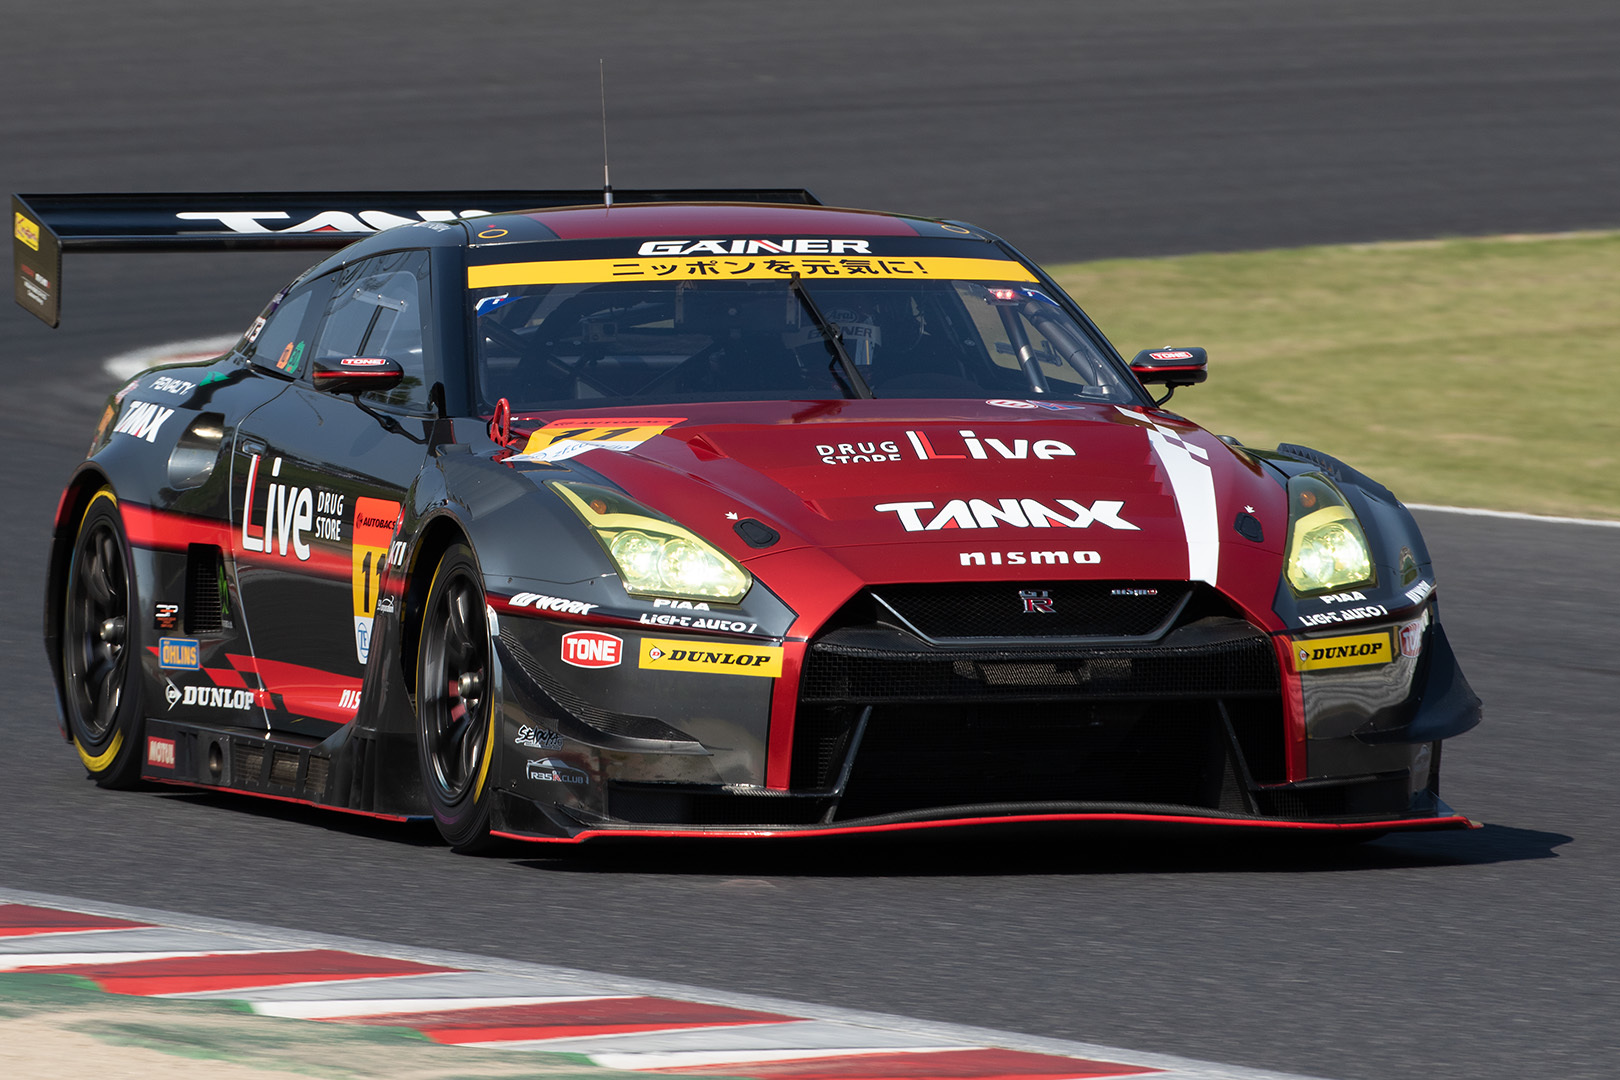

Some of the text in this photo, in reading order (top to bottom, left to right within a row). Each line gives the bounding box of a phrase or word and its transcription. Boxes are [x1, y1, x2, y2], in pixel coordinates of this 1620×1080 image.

[176, 211, 495, 233] TAN
[637, 239, 873, 256] GAINER
[612, 258, 927, 276] ニッポンを元気に!
[807, 325, 873, 340] GNER
[815, 440, 900, 456] DRUG
[905, 430, 1077, 461] Live
[242, 454, 313, 562] Live
[317, 491, 345, 516] DRUG
[362, 516, 396, 531] AUTOBACS
[873, 498, 1144, 533] TANAX
[315, 516, 341, 542] STORE
[959, 550, 1102, 567] nismo
[535, 594, 600, 616] WORK
[653, 598, 711, 612] PIAA
[1319, 590, 1367, 604] PIAA
[162, 640, 197, 666] ÖHLINS
[566, 637, 617, 662] TONE
[667, 649, 771, 667] DUNLOP
[1311, 642, 1383, 660] DUNLOP
[182, 685, 254, 710] DUNLOP
[149, 740, 175, 765] MOTUL
